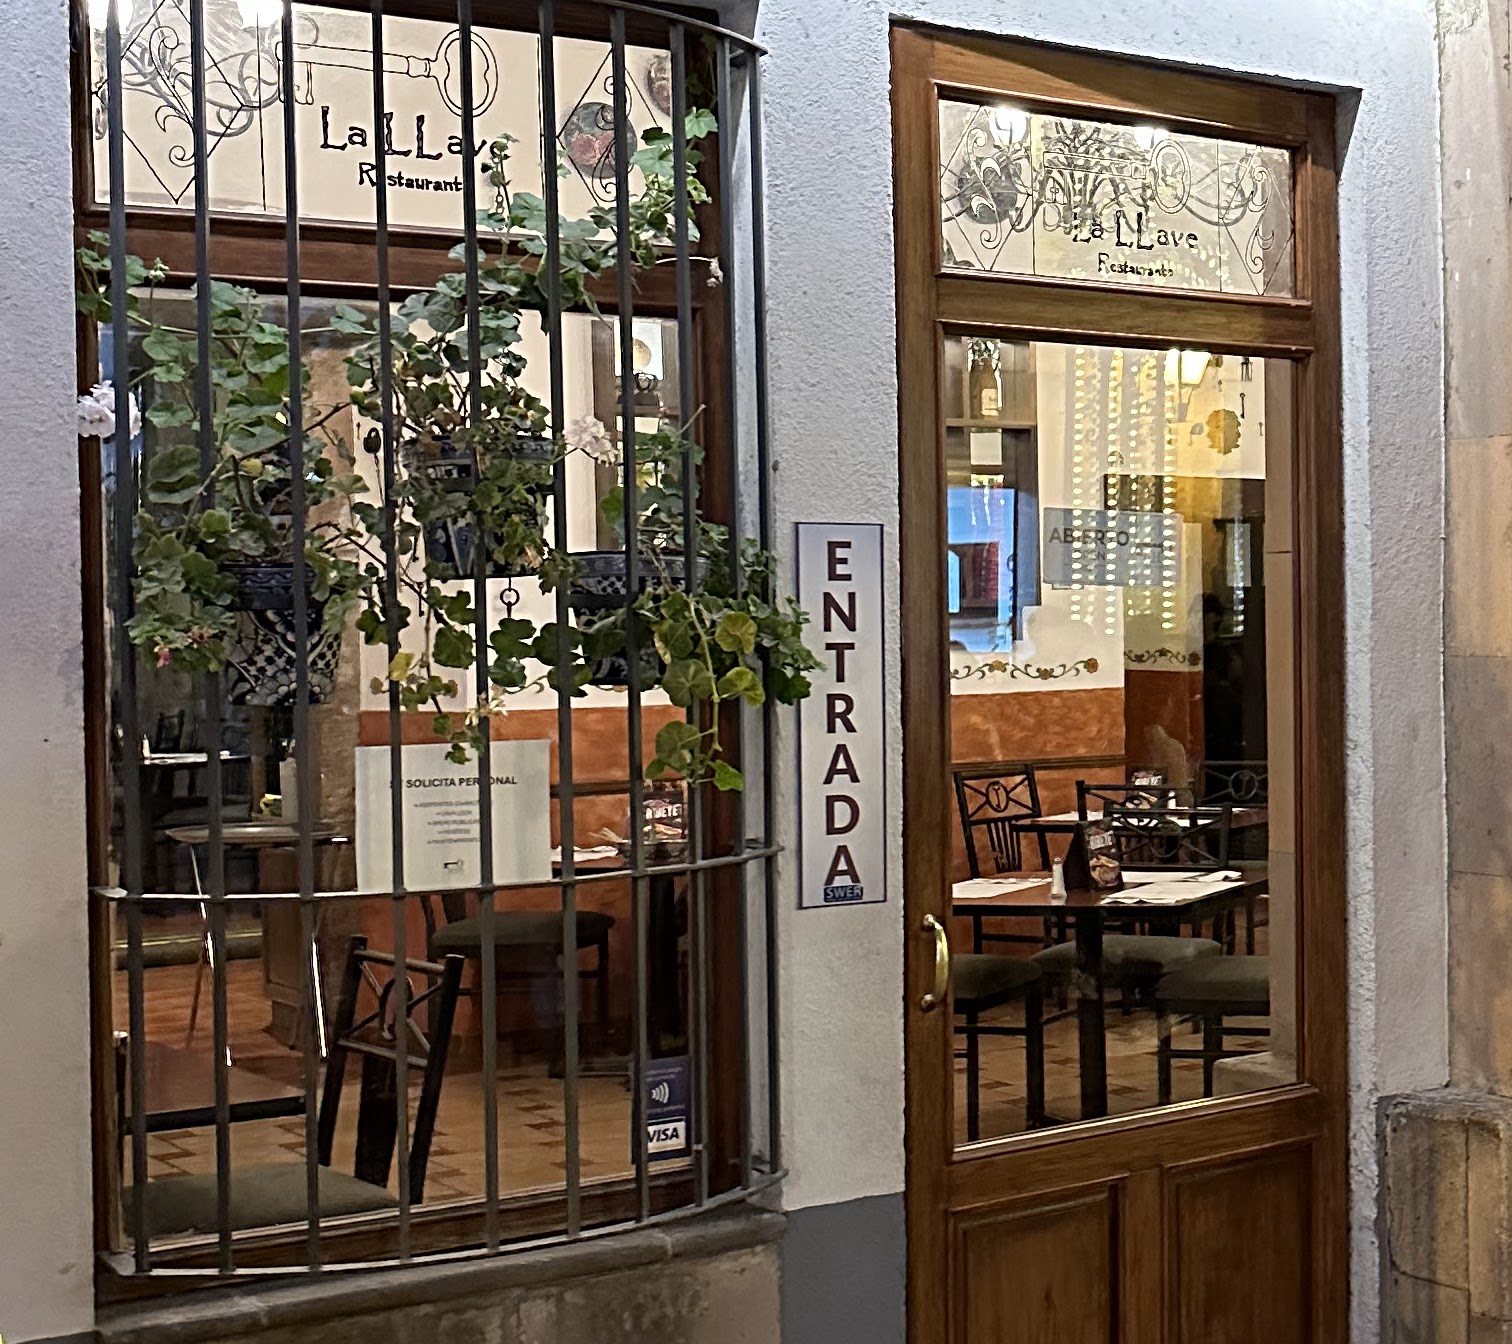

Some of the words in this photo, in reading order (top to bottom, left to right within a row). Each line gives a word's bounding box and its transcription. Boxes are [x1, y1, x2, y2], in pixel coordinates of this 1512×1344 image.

[320, 106, 367, 151] La
[359, 161, 466, 192] Rstaurant
[1072, 211, 1104, 244] La
[1115, 209, 1199, 250] LLave
[1098, 252, 1174, 277] Restaurante
[1049, 527, 1130, 547] ABERO
[822, 540, 861, 886] ENTRADA
[405, 777, 457, 789] SOLICITA
[458, 775, 518, 787] PERONAL
[648, 1127, 680, 1143] VISA
